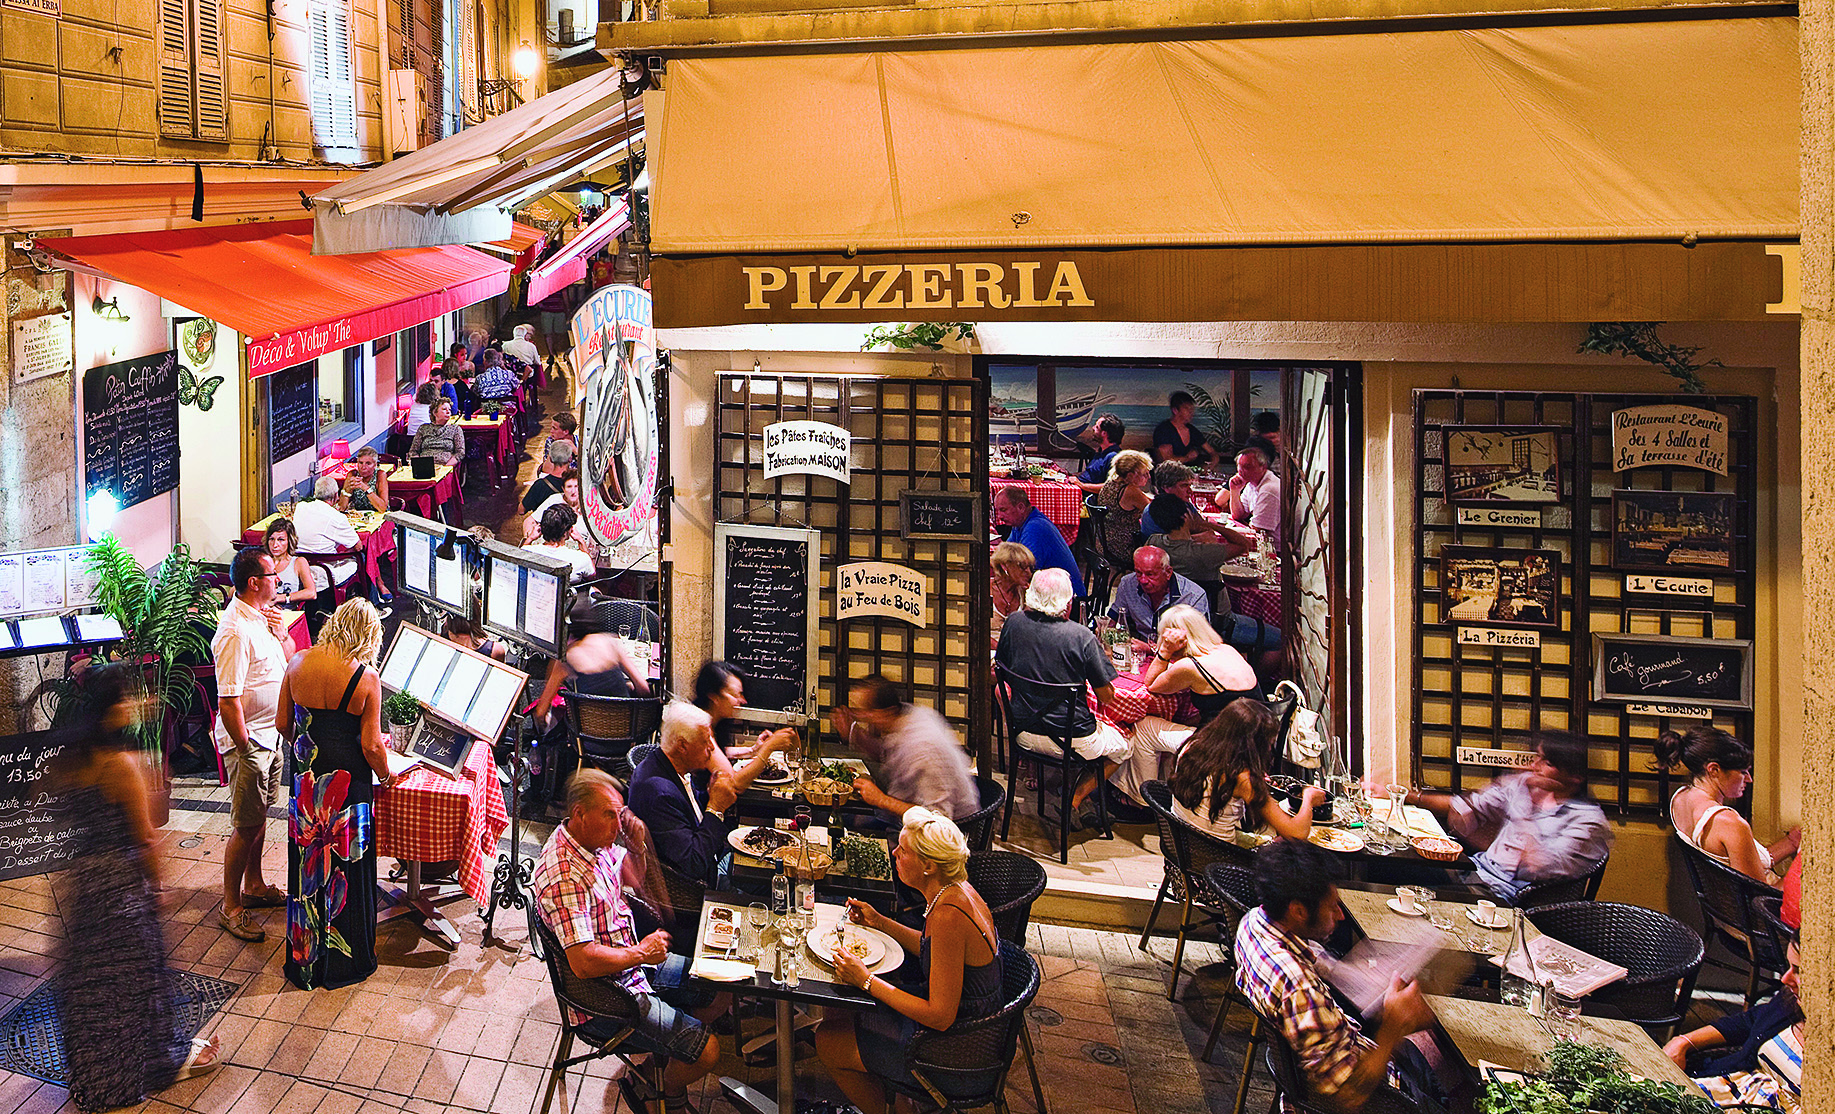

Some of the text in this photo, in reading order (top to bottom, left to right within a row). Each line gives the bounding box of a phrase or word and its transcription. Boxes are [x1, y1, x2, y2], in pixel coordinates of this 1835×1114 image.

[742, 261, 1095, 310] PIZZERIA
[575, 290, 652, 346] L'ECURIE
[251, 341, 283, 370] Déco
[285, 336, 295, 358] &
[1615, 411, 1723, 433] Restaurant L'Ecurie
[781, 429, 807, 444] Pâtes
[808, 429, 847, 452] Fraîches
[1629, 428, 1710, 448] Ses 4 Salles et
[766, 451, 808, 471] Fabrication
[1617, 447, 1724, 471] Sa terrasse d'été
[913, 501, 958, 513] Salade du
[1464, 510, 1537, 525] Le Grenier
[914, 513, 933, 530] chef
[854, 569, 887, 585] Vraie
[889, 574, 922, 596] Pizza
[840, 592, 920, 617] au Feu de Bois
[1463, 630, 1535, 645] La Pizzéria
[1609, 652, 1635, 678] Café
[1637, 652, 1684, 685] gourmand
[17, 747, 31, 762] du
[35, 745, 65, 769] jour
[1462, 749, 1474, 762] La
[1475, 751, 1513, 765] Terrasse
[7, 766, 50, 783] 13,50€
[34, 792, 58, 808] Duo
[0, 812, 54, 829] sauce daube
[44, 831, 55, 842] de
[1, 848, 54, 870] Dessert
[53, 848, 66, 859] du
